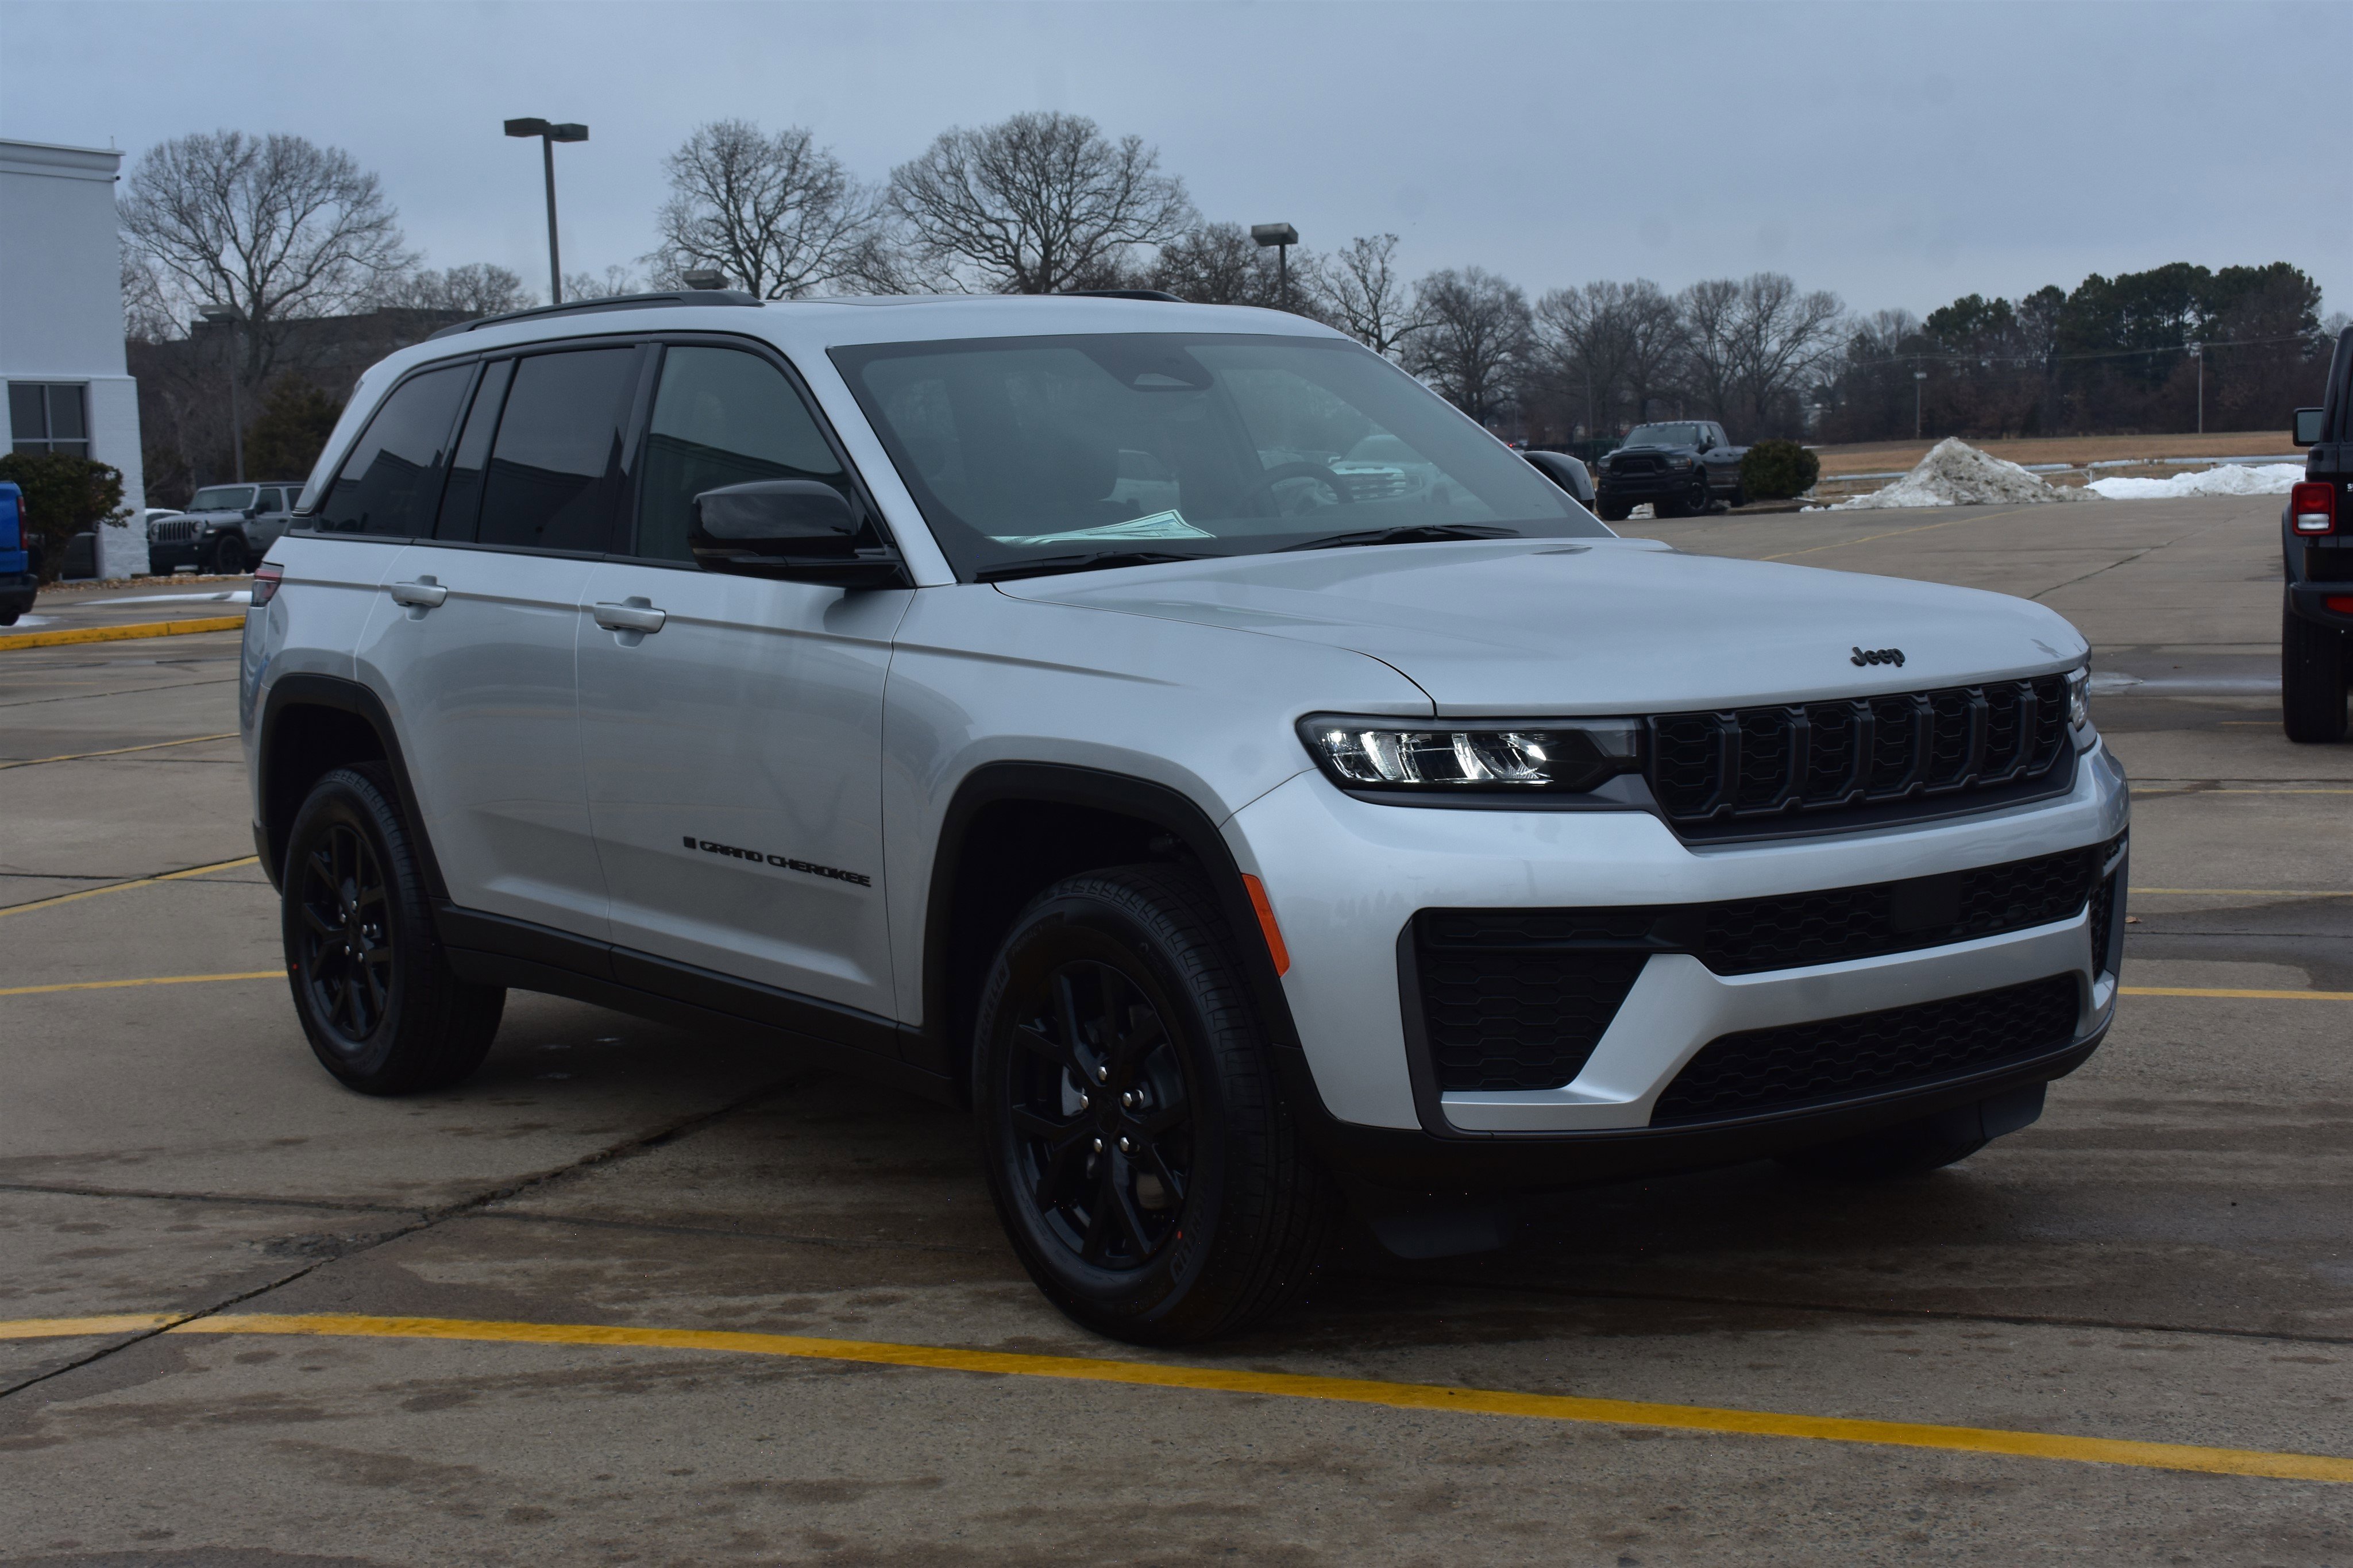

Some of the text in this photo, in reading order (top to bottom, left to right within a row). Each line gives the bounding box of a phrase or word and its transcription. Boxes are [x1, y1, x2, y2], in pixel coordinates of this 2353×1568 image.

[1850, 646, 1906, 667] Jeep
[700, 840, 871, 887] GRAND CHEROKEE
